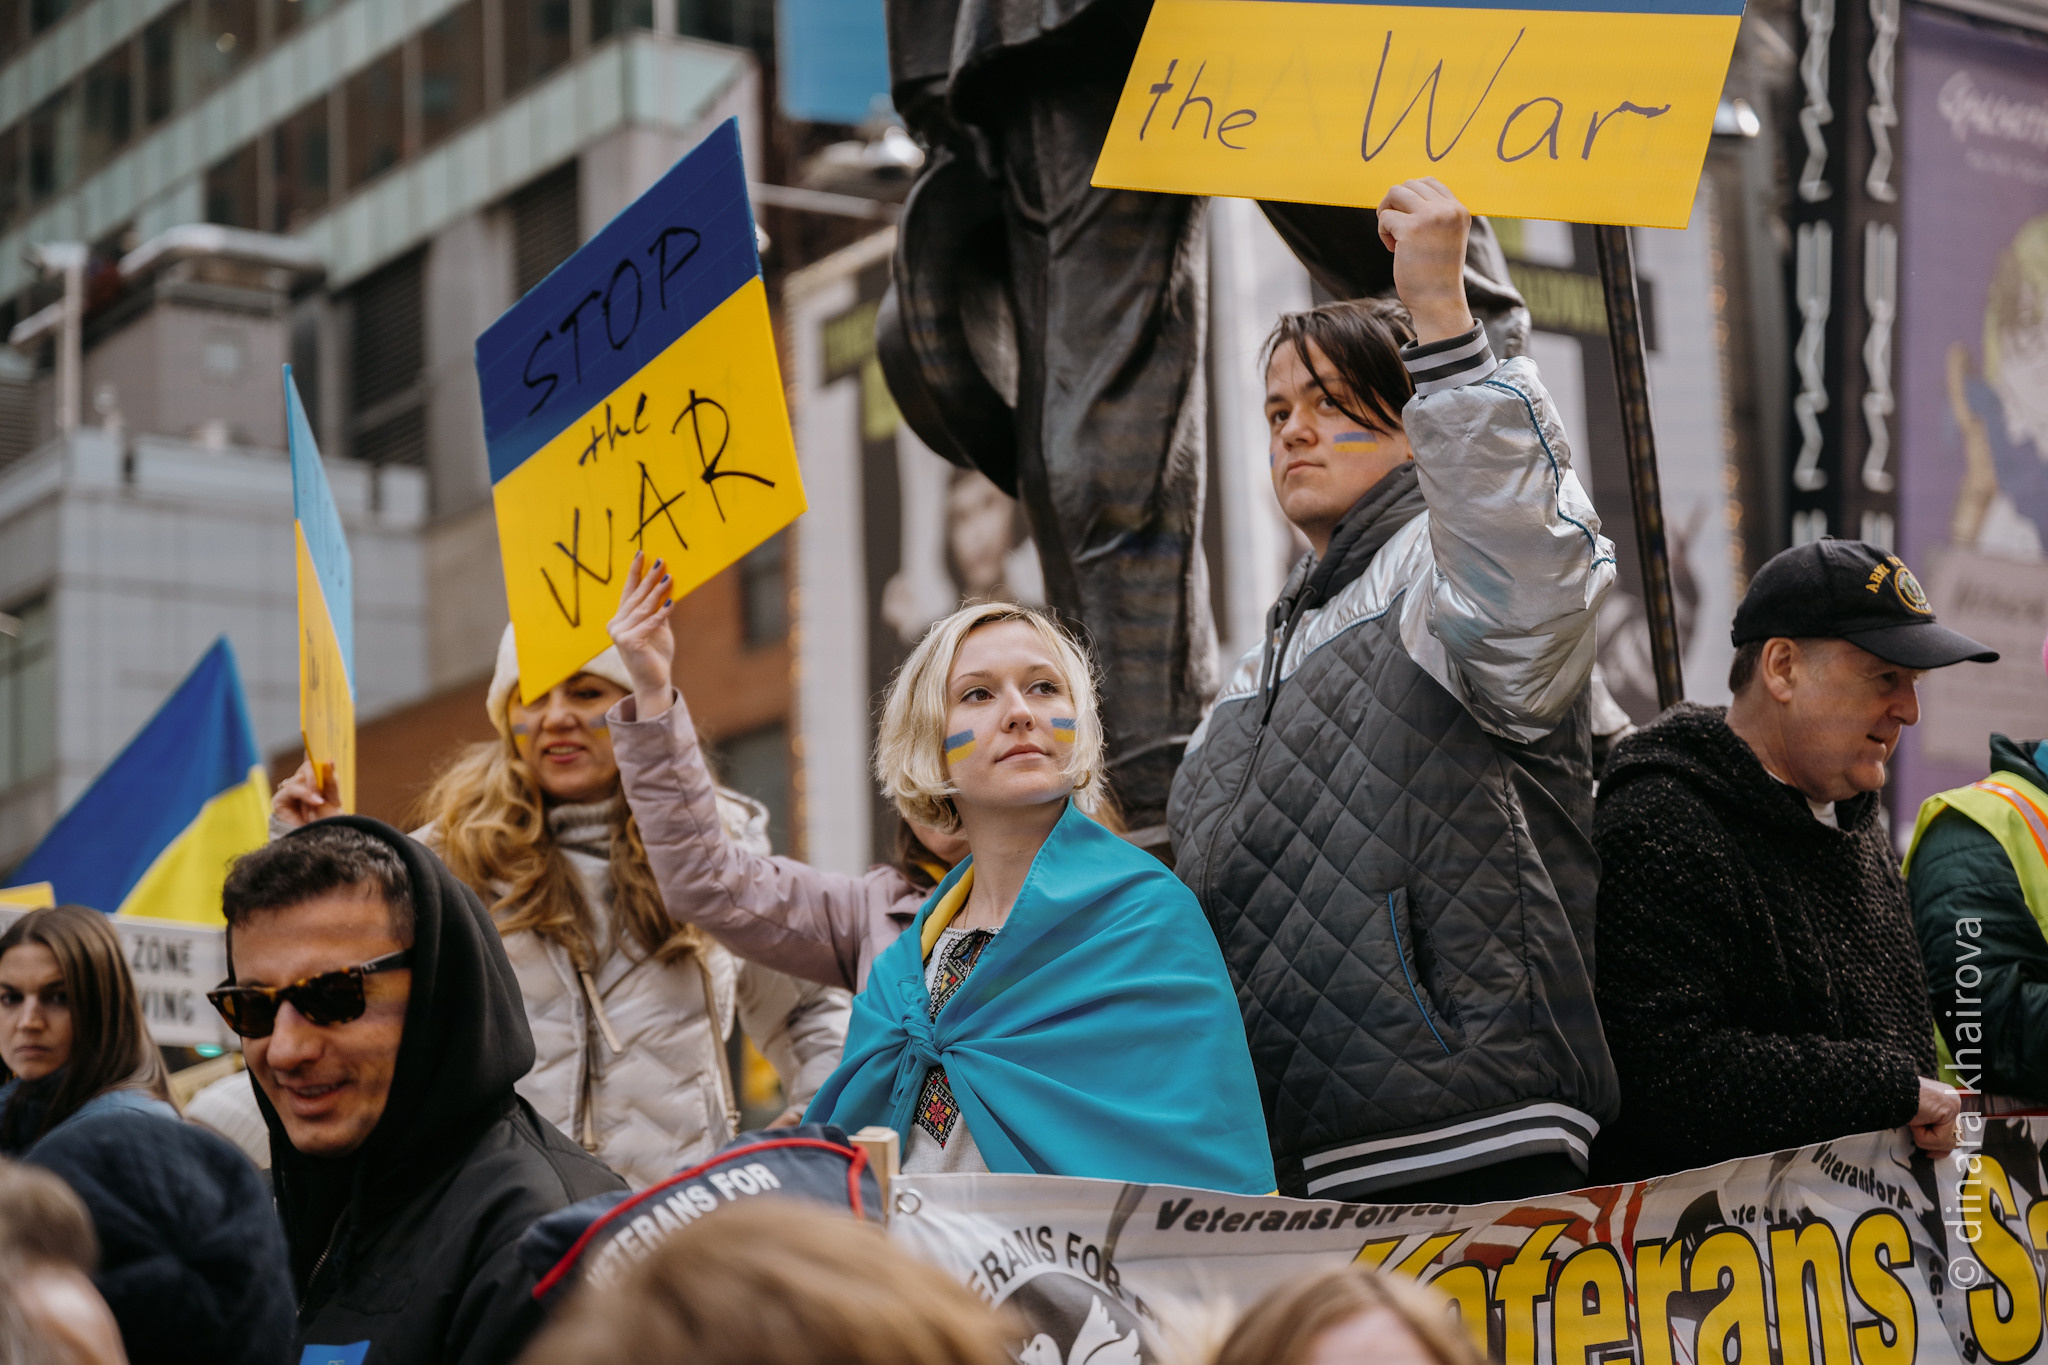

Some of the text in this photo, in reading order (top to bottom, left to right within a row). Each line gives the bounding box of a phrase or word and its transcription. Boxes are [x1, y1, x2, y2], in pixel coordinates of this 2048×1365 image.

[1140, 58, 1257, 150] the
[1361, 26, 1673, 162] War
[523, 226, 701, 417] STOP
[578, 392, 651, 467] the
[540, 388, 776, 629] WAR
[131, 934, 194, 978] ZONE
[708, 1162, 782, 1202] FOR
[1065, 1231, 1124, 1301] FOR
